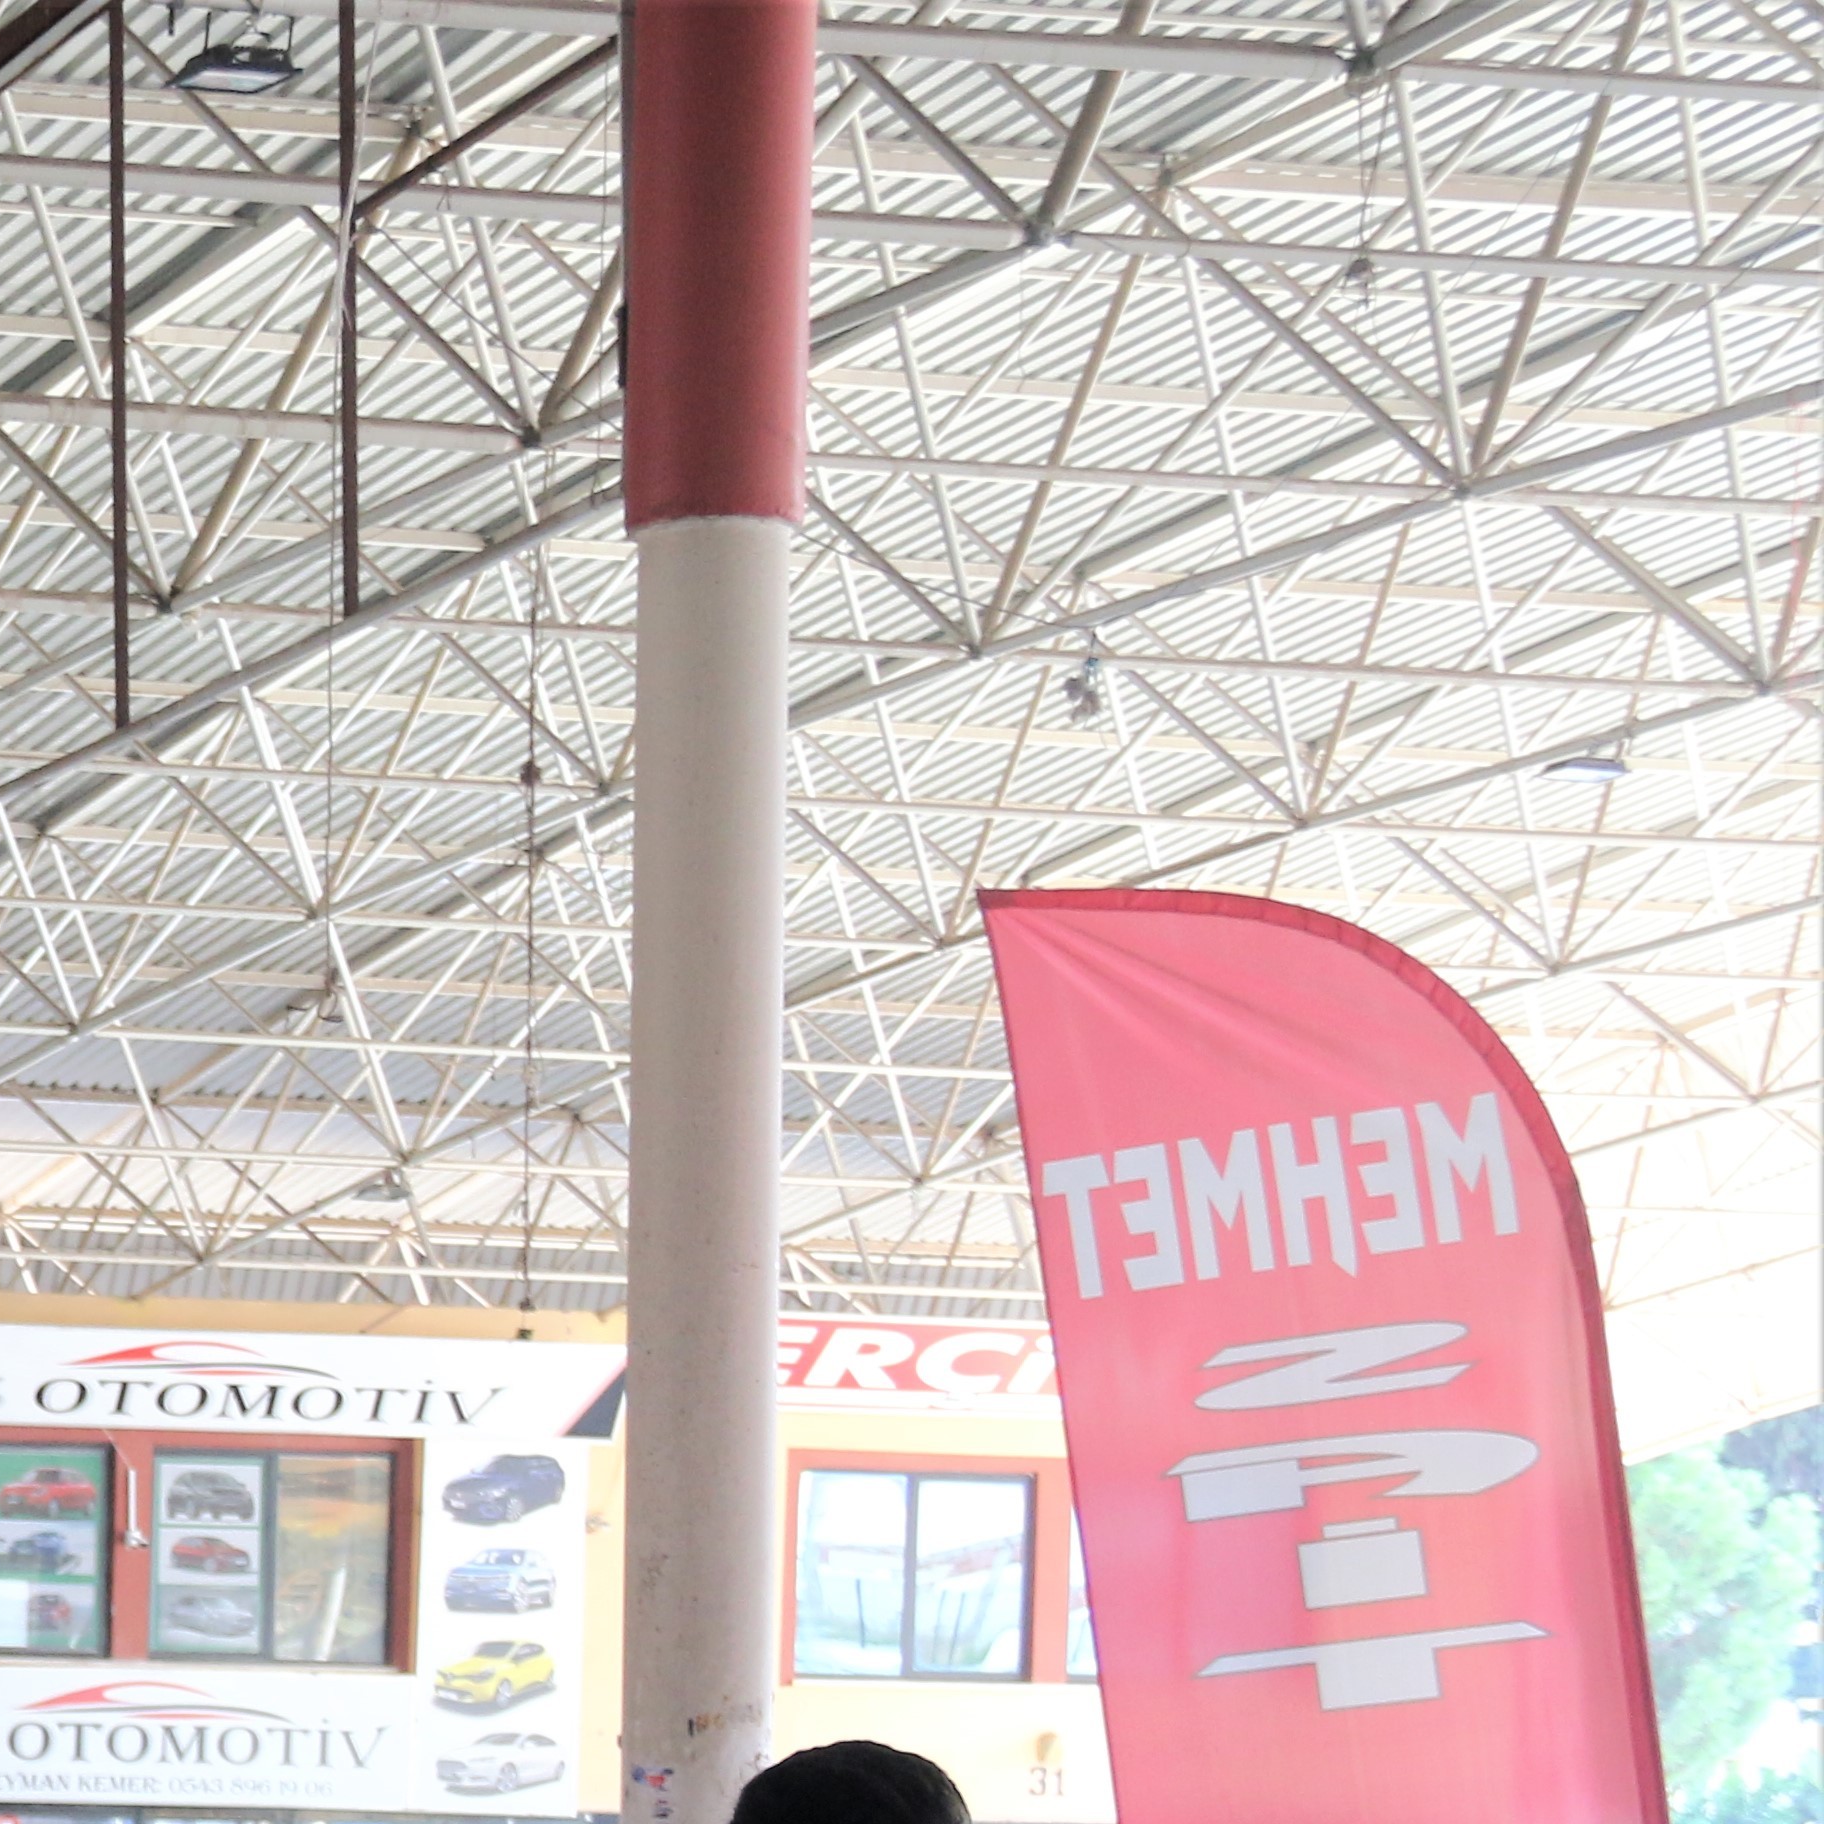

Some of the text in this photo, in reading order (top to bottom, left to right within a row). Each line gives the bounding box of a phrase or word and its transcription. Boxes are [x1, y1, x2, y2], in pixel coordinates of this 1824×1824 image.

[34, 1377, 508, 1427] OTOMOTİV
[7, 1718, 391, 1769] OTOMOTİV
[1029, 1766, 1064, 1797] 31
